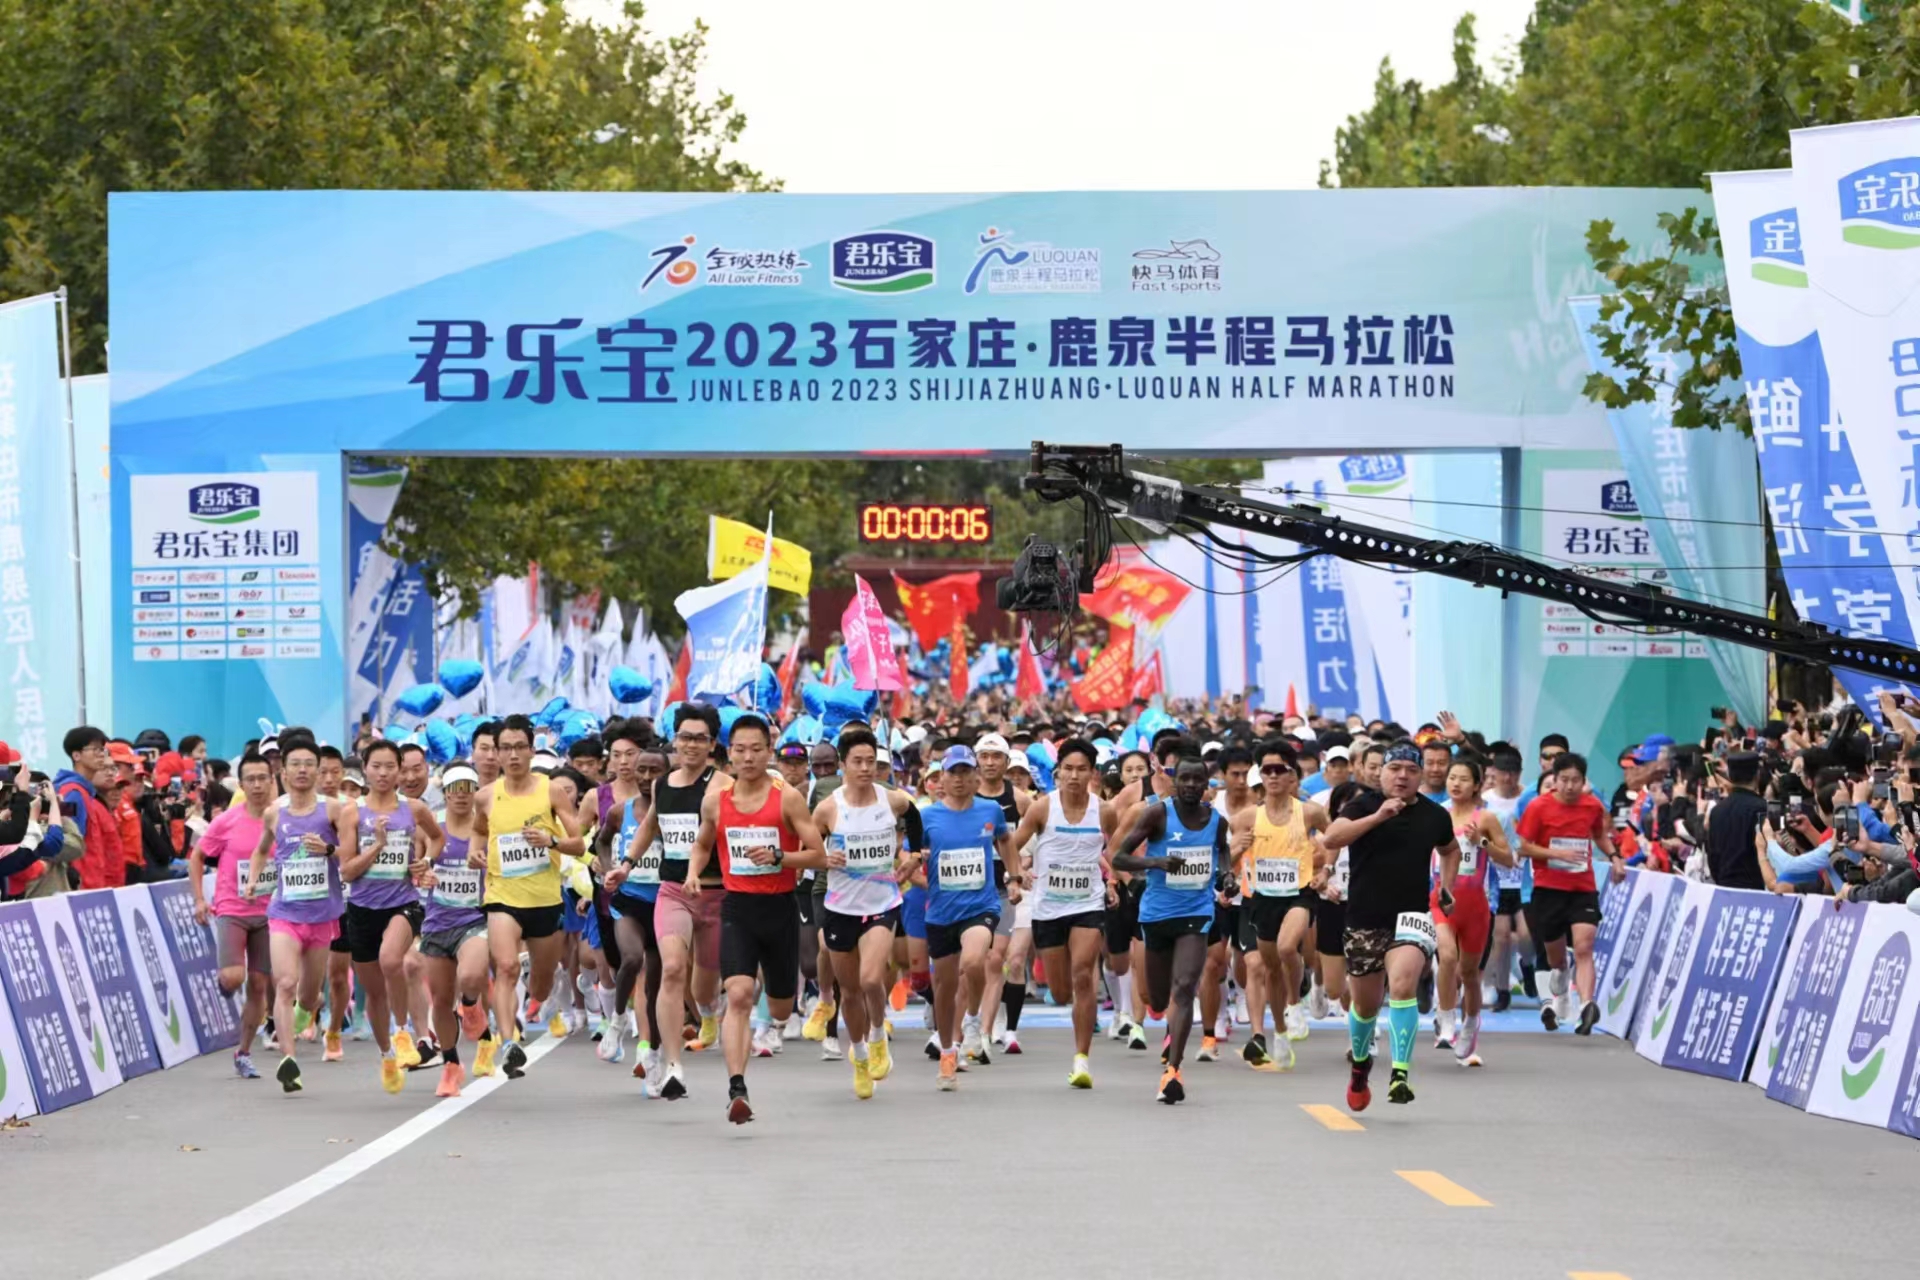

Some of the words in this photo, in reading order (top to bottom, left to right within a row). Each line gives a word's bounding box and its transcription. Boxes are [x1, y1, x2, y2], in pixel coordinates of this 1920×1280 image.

[845, 241, 923, 267] 君乐宝
[1032, 250, 1098, 263] LUQUAN
[708, 274, 725, 284] All
[728, 274, 755, 284] Love
[757, 274, 800, 284] Fitness
[1132, 264, 1220, 280] 快马体育
[1132, 281, 1166, 291] Fast
[1171, 282, 1221, 293] sports
[408, 318, 678, 404] 君乐宝
[688, 378, 819, 402] JUNLEBAO
[832, 378, 898, 401] 2023
[1233, 376, 1296, 398] HALF
[1309, 375, 1455, 397] MARATHON
[197, 487, 252, 506] 君乐宝
[864, 507, 988, 540] 00:00:06
[153, 530, 299, 558] 君乐宝集团
[1563, 527, 1650, 555] 君乐宝
[374, 853, 404, 865] 3299
[502, 847, 546, 863] M0412
[848, 844, 891, 860] M1059
[941, 864, 982, 877] M1674
[1257, 872, 1296, 883] M0478
[285, 873, 325, 886] M0236
[438, 882, 477, 893] M1203
[1049, 876, 1090, 889] M1160
[1705, 904, 1775, 980] 科学营养
[1678, 988, 1748, 1064] 鲜活力量
